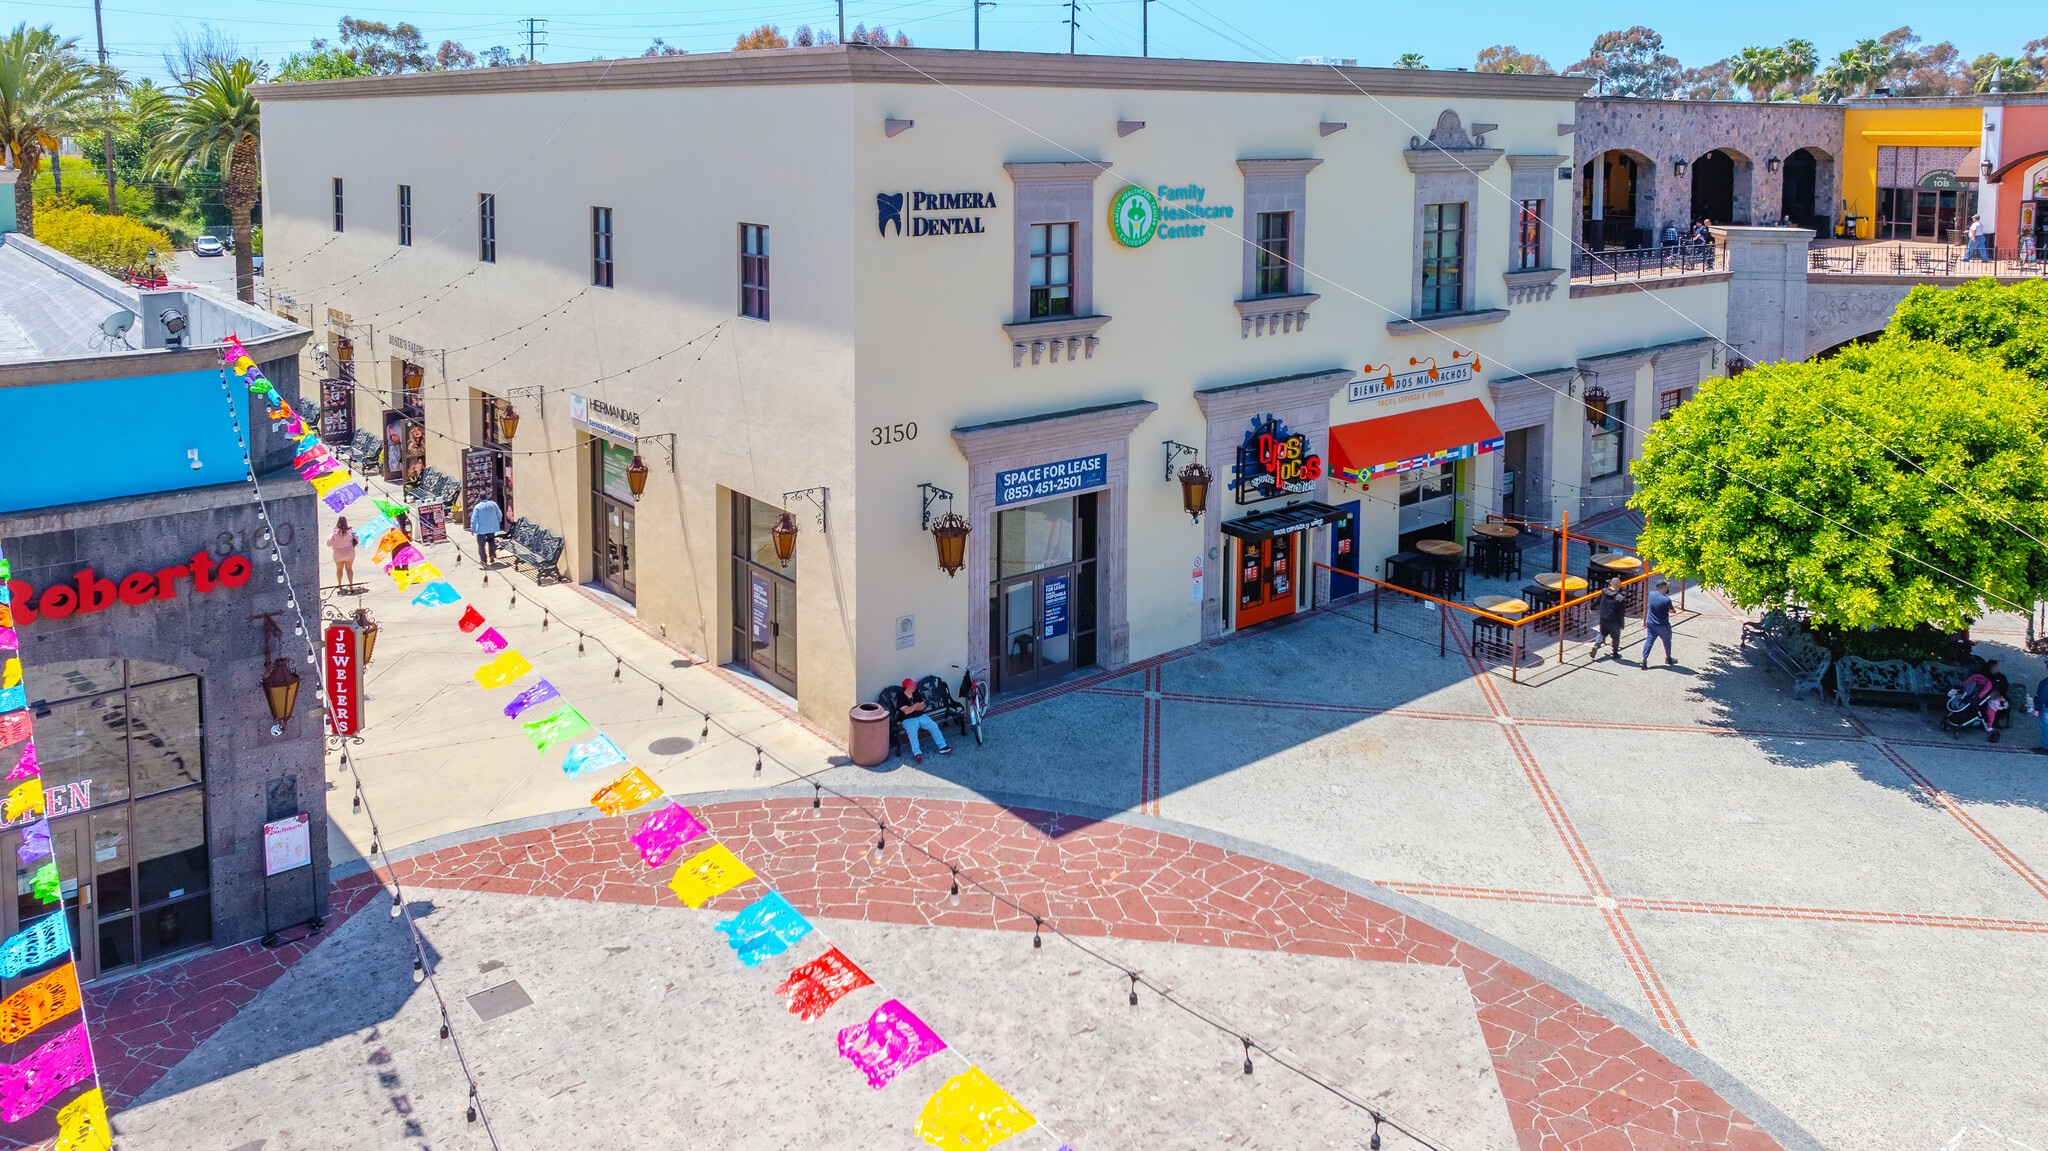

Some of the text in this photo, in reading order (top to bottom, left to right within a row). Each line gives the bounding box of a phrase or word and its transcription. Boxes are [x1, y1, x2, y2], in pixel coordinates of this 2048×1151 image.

[912, 191, 997, 211] PRIMERA
[1158, 184, 1206, 203] Family
[1158, 203, 1234, 221] Healthcare
[912, 217, 985, 237] DENTAL
[1157, 224, 1206, 240] Center
[589, 398, 640, 426] HERMANDAD
[870, 421, 918, 446] 3150
[1003, 457, 1101, 487] SPACE FOR LEASE
[1003, 475, 1082, 502] (855) 451-2501
[214, 522, 295, 557] 3160
[0, 550, 252, 626] Roberto
[332, 630, 350, 732] JEWELERS
[0, 779, 93, 829] OEN
